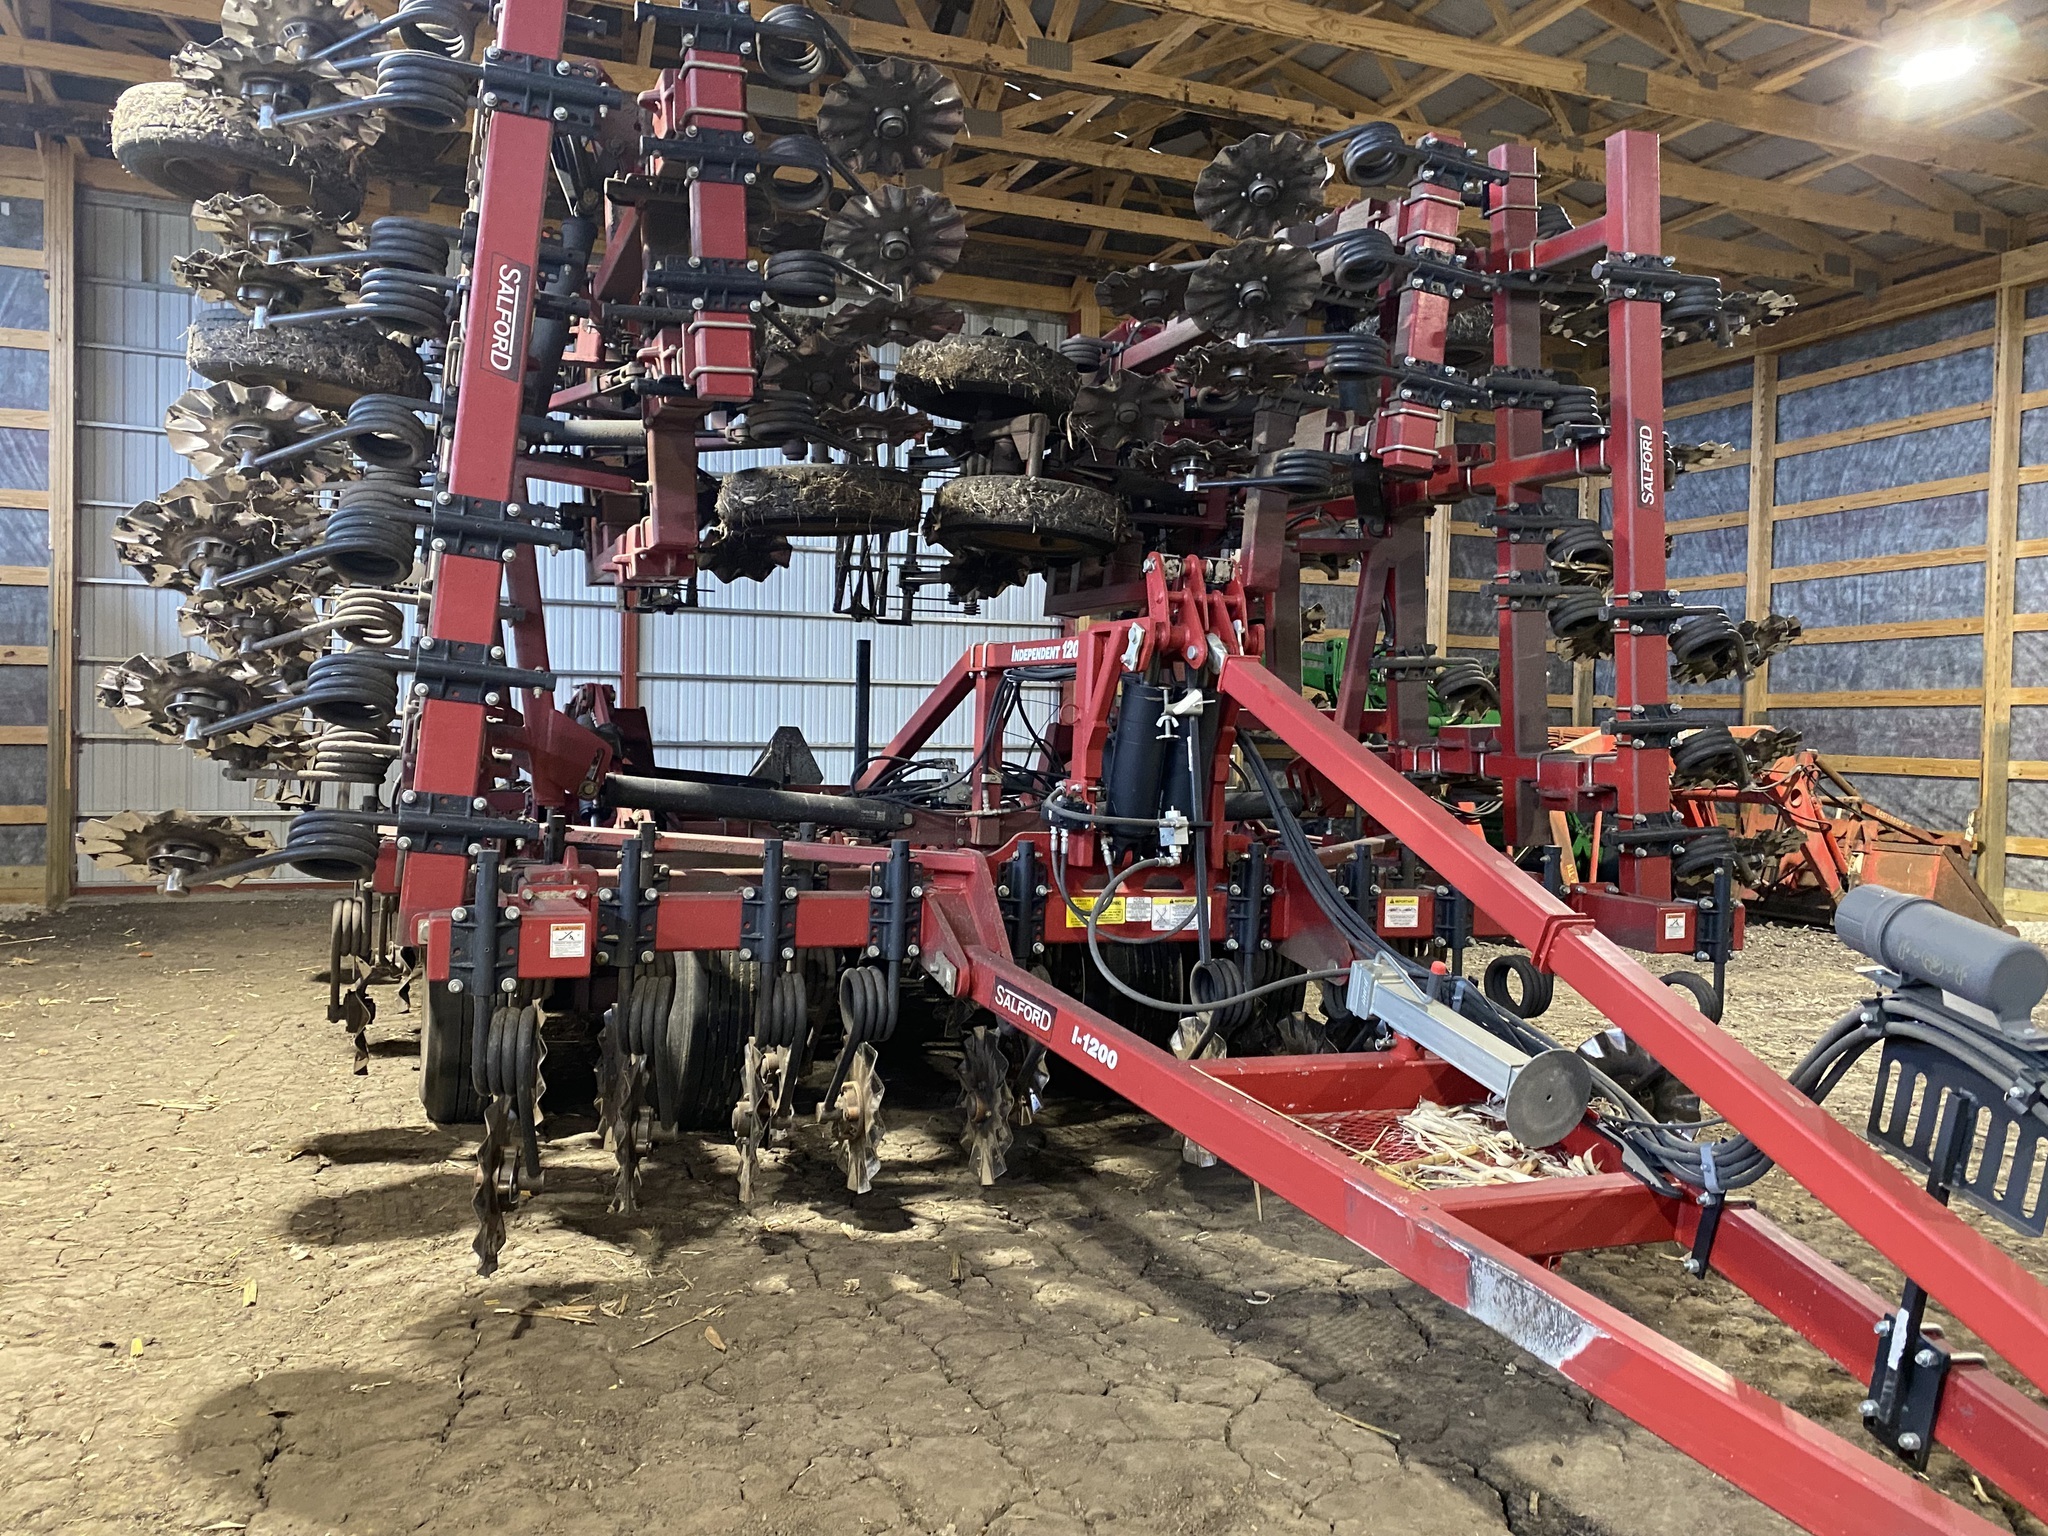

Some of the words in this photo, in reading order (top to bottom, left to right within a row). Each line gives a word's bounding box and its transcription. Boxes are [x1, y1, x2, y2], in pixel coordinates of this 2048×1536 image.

[490, 264, 521, 371] SALFORD
[1639, 425, 1654, 505] SALFORD
[994, 985, 1051, 1032] SALFORD
[1071, 1025, 1118, 1070] I-1200
